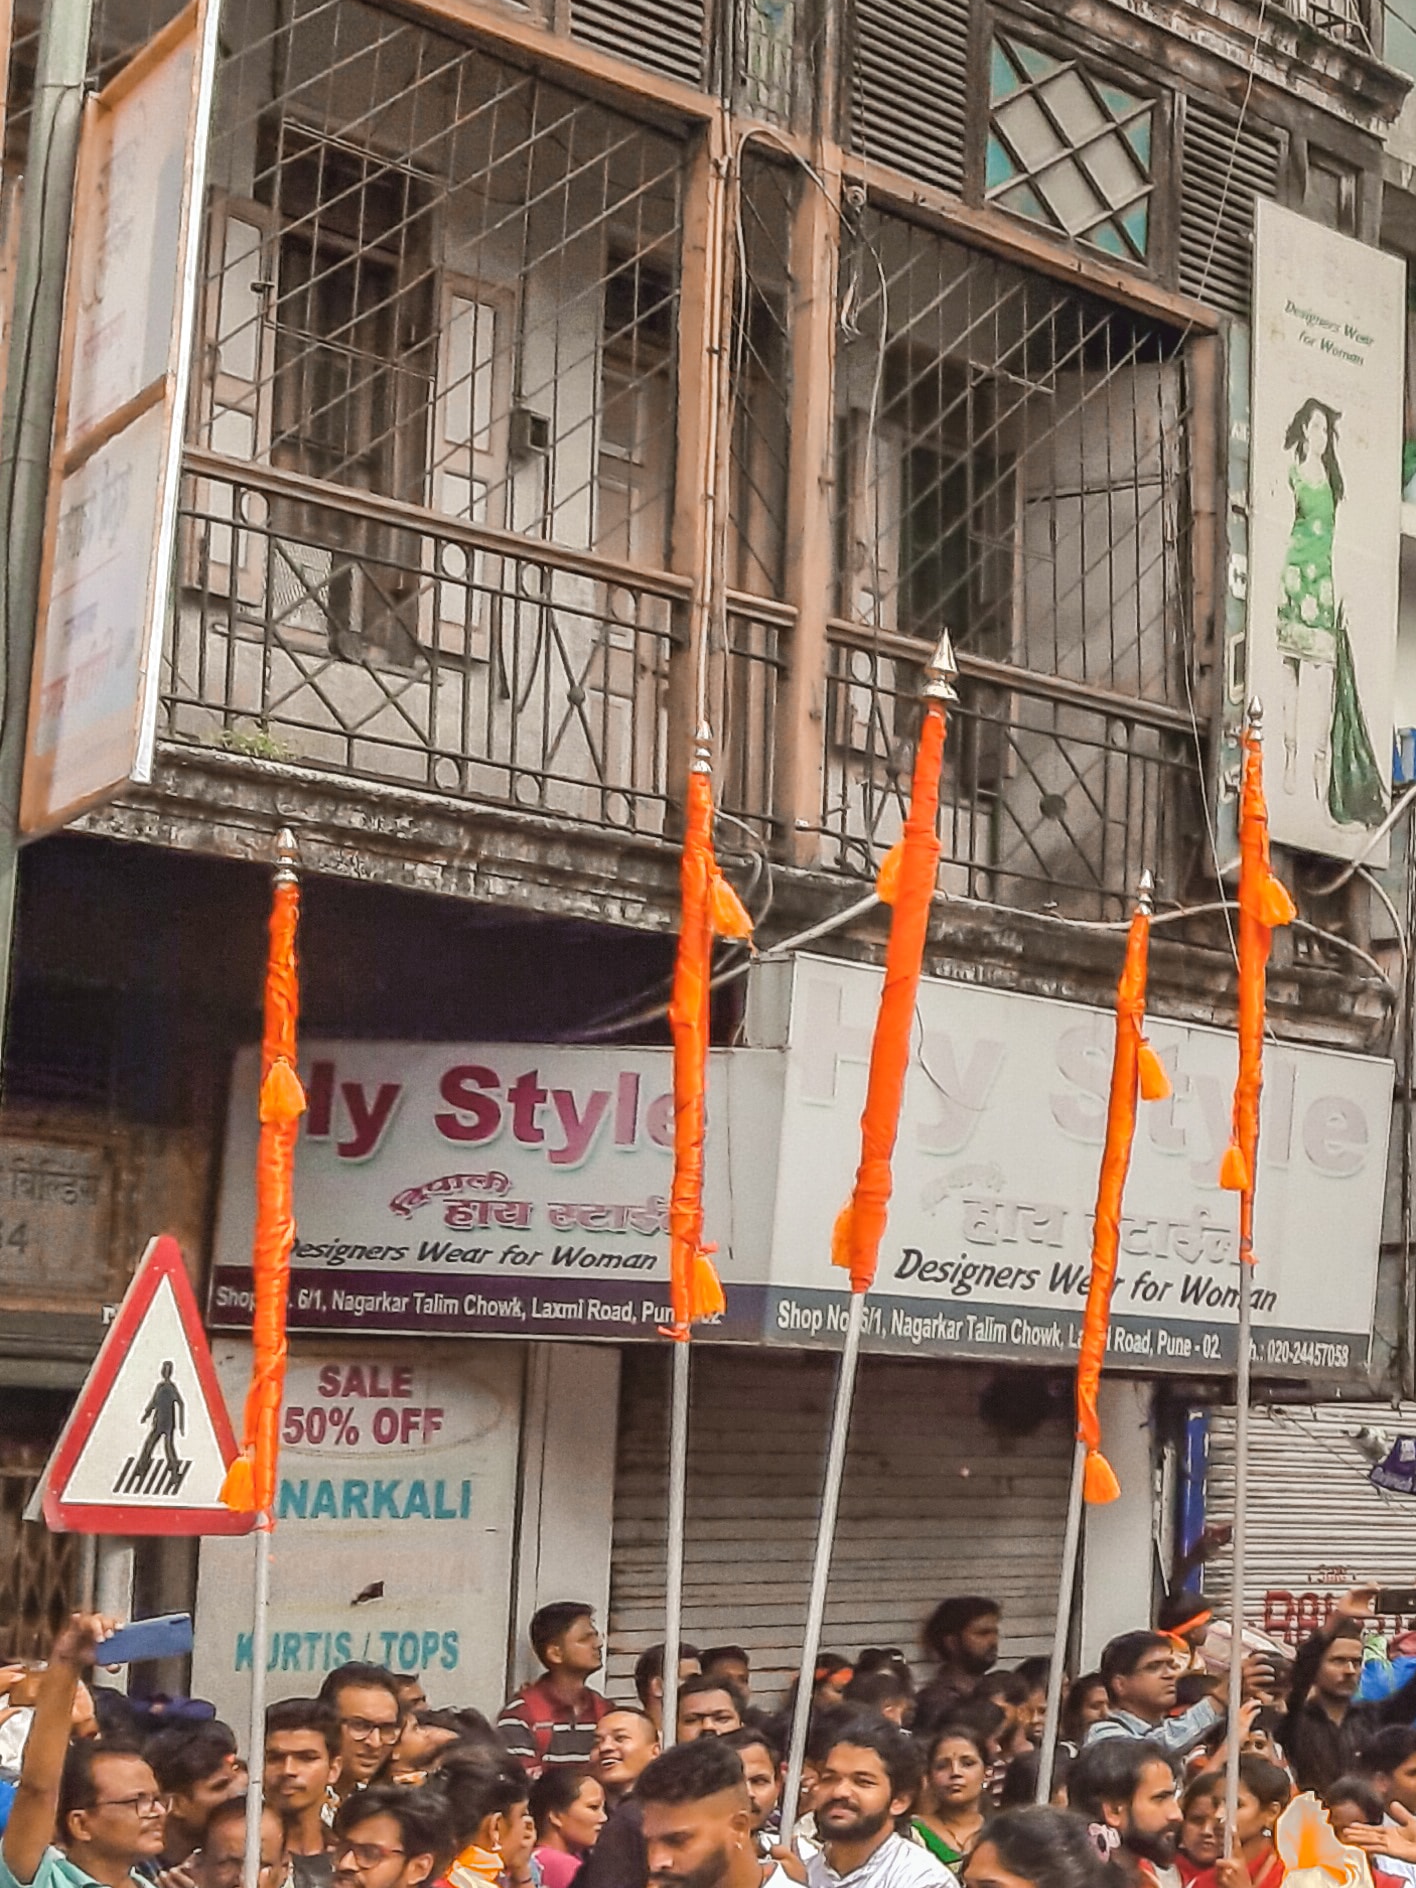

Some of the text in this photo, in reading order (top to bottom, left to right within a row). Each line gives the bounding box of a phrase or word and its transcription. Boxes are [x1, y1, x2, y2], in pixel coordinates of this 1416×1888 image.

[546, 1194, 674, 1238] स्टाई
[290, 1238, 659, 1272] esigners Wear for Woman
[894, 1247, 1278, 1314] Designers Wer for Woman
[332, 1291, 409, 1318] Nagarkar
[413, 1293, 460, 1315] Talim
[464, 1293, 527, 1321] Chowk,
[532, 1298, 585, 1322] Laxmi
[588, 1300, 637, 1327] Road,
[642, 1302, 675, 1324] Pun
[777, 1298, 823, 1334] Shop
[890, 1310, 963, 1345] Nagarkar
[966, 1315, 1008, 1346] Talim
[1010, 1319, 1066, 1351] Chowk,
[1115, 1326, 1154, 1358] Road,
[1157, 1329, 1193, 1359] Pune
[318, 1365, 414, 1399] SALE
[281, 1407, 445, 1446] 50% OFF
[278, 1479, 473, 1520] NARKALI
[380, 1630, 460, 1672] TOPS
